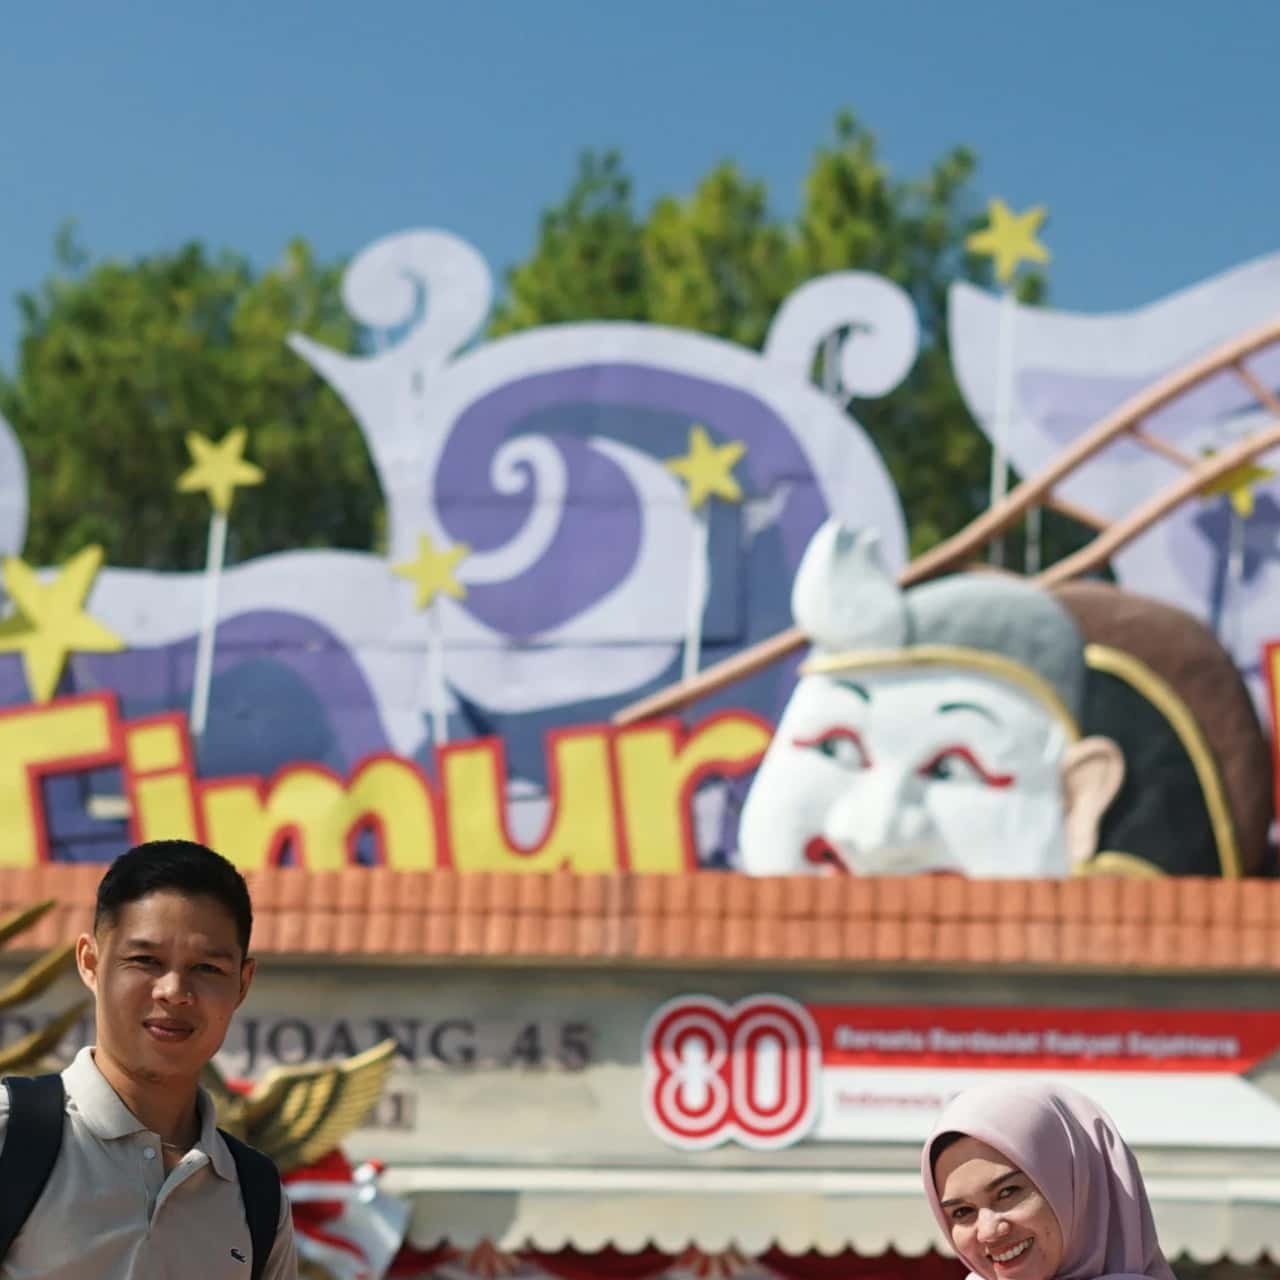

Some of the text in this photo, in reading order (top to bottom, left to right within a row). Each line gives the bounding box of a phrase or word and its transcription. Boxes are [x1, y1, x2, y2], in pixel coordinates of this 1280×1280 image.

[239, 1018, 476, 1077] JOANG
[510, 1022, 593, 1073] 45
[644, 996, 819, 1147] 80
